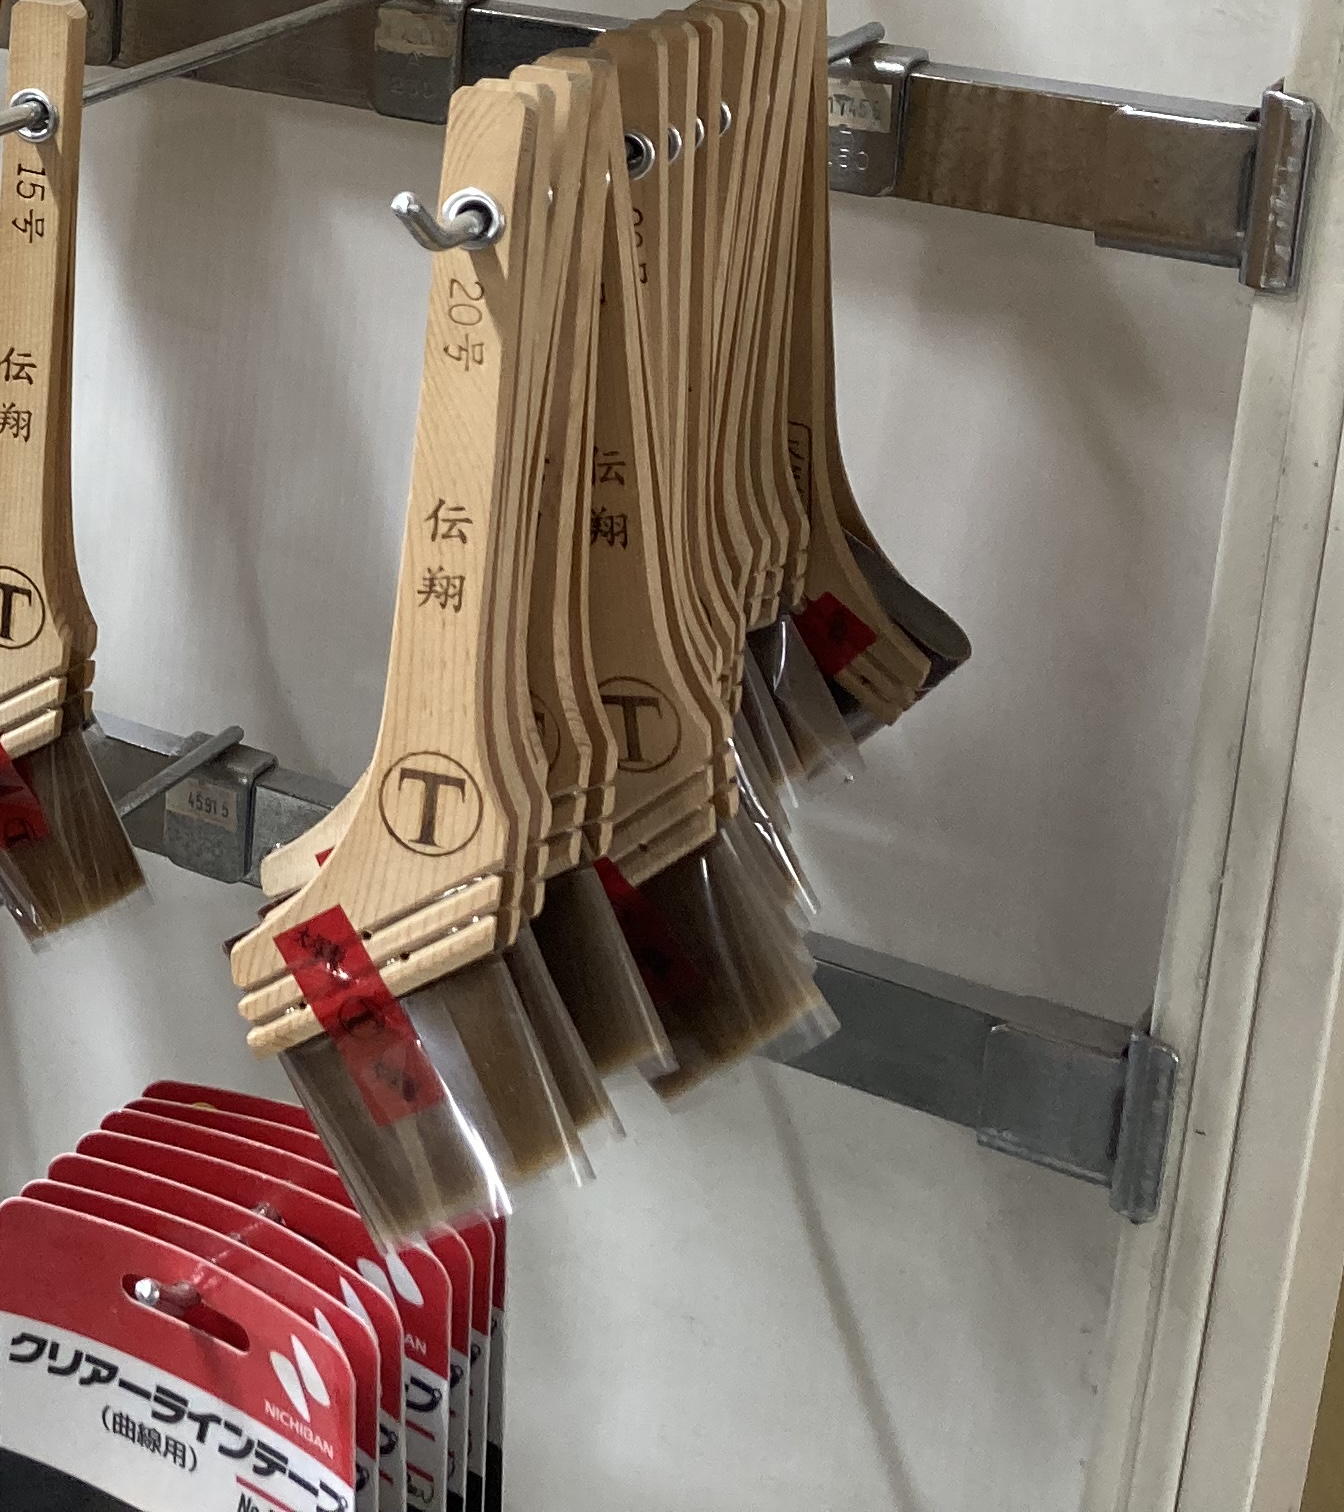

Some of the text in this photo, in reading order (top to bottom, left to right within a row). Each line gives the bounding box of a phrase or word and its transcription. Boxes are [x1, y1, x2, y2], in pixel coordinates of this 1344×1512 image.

[11, 162, 46, 244] 15号
[443, 277, 485, 372] 20号
[591, 447, 630, 550] 伝翔
[417, 497, 473, 613] 伝翔
[599, 686, 672, 768] T
[387, 759, 475, 852] T
[9, 1329, 349, 1512] クリアーラインテープ
[100, 1404, 199, 1474] (曲線用)
[264, 1398, 335, 1460] NICHIBAN
